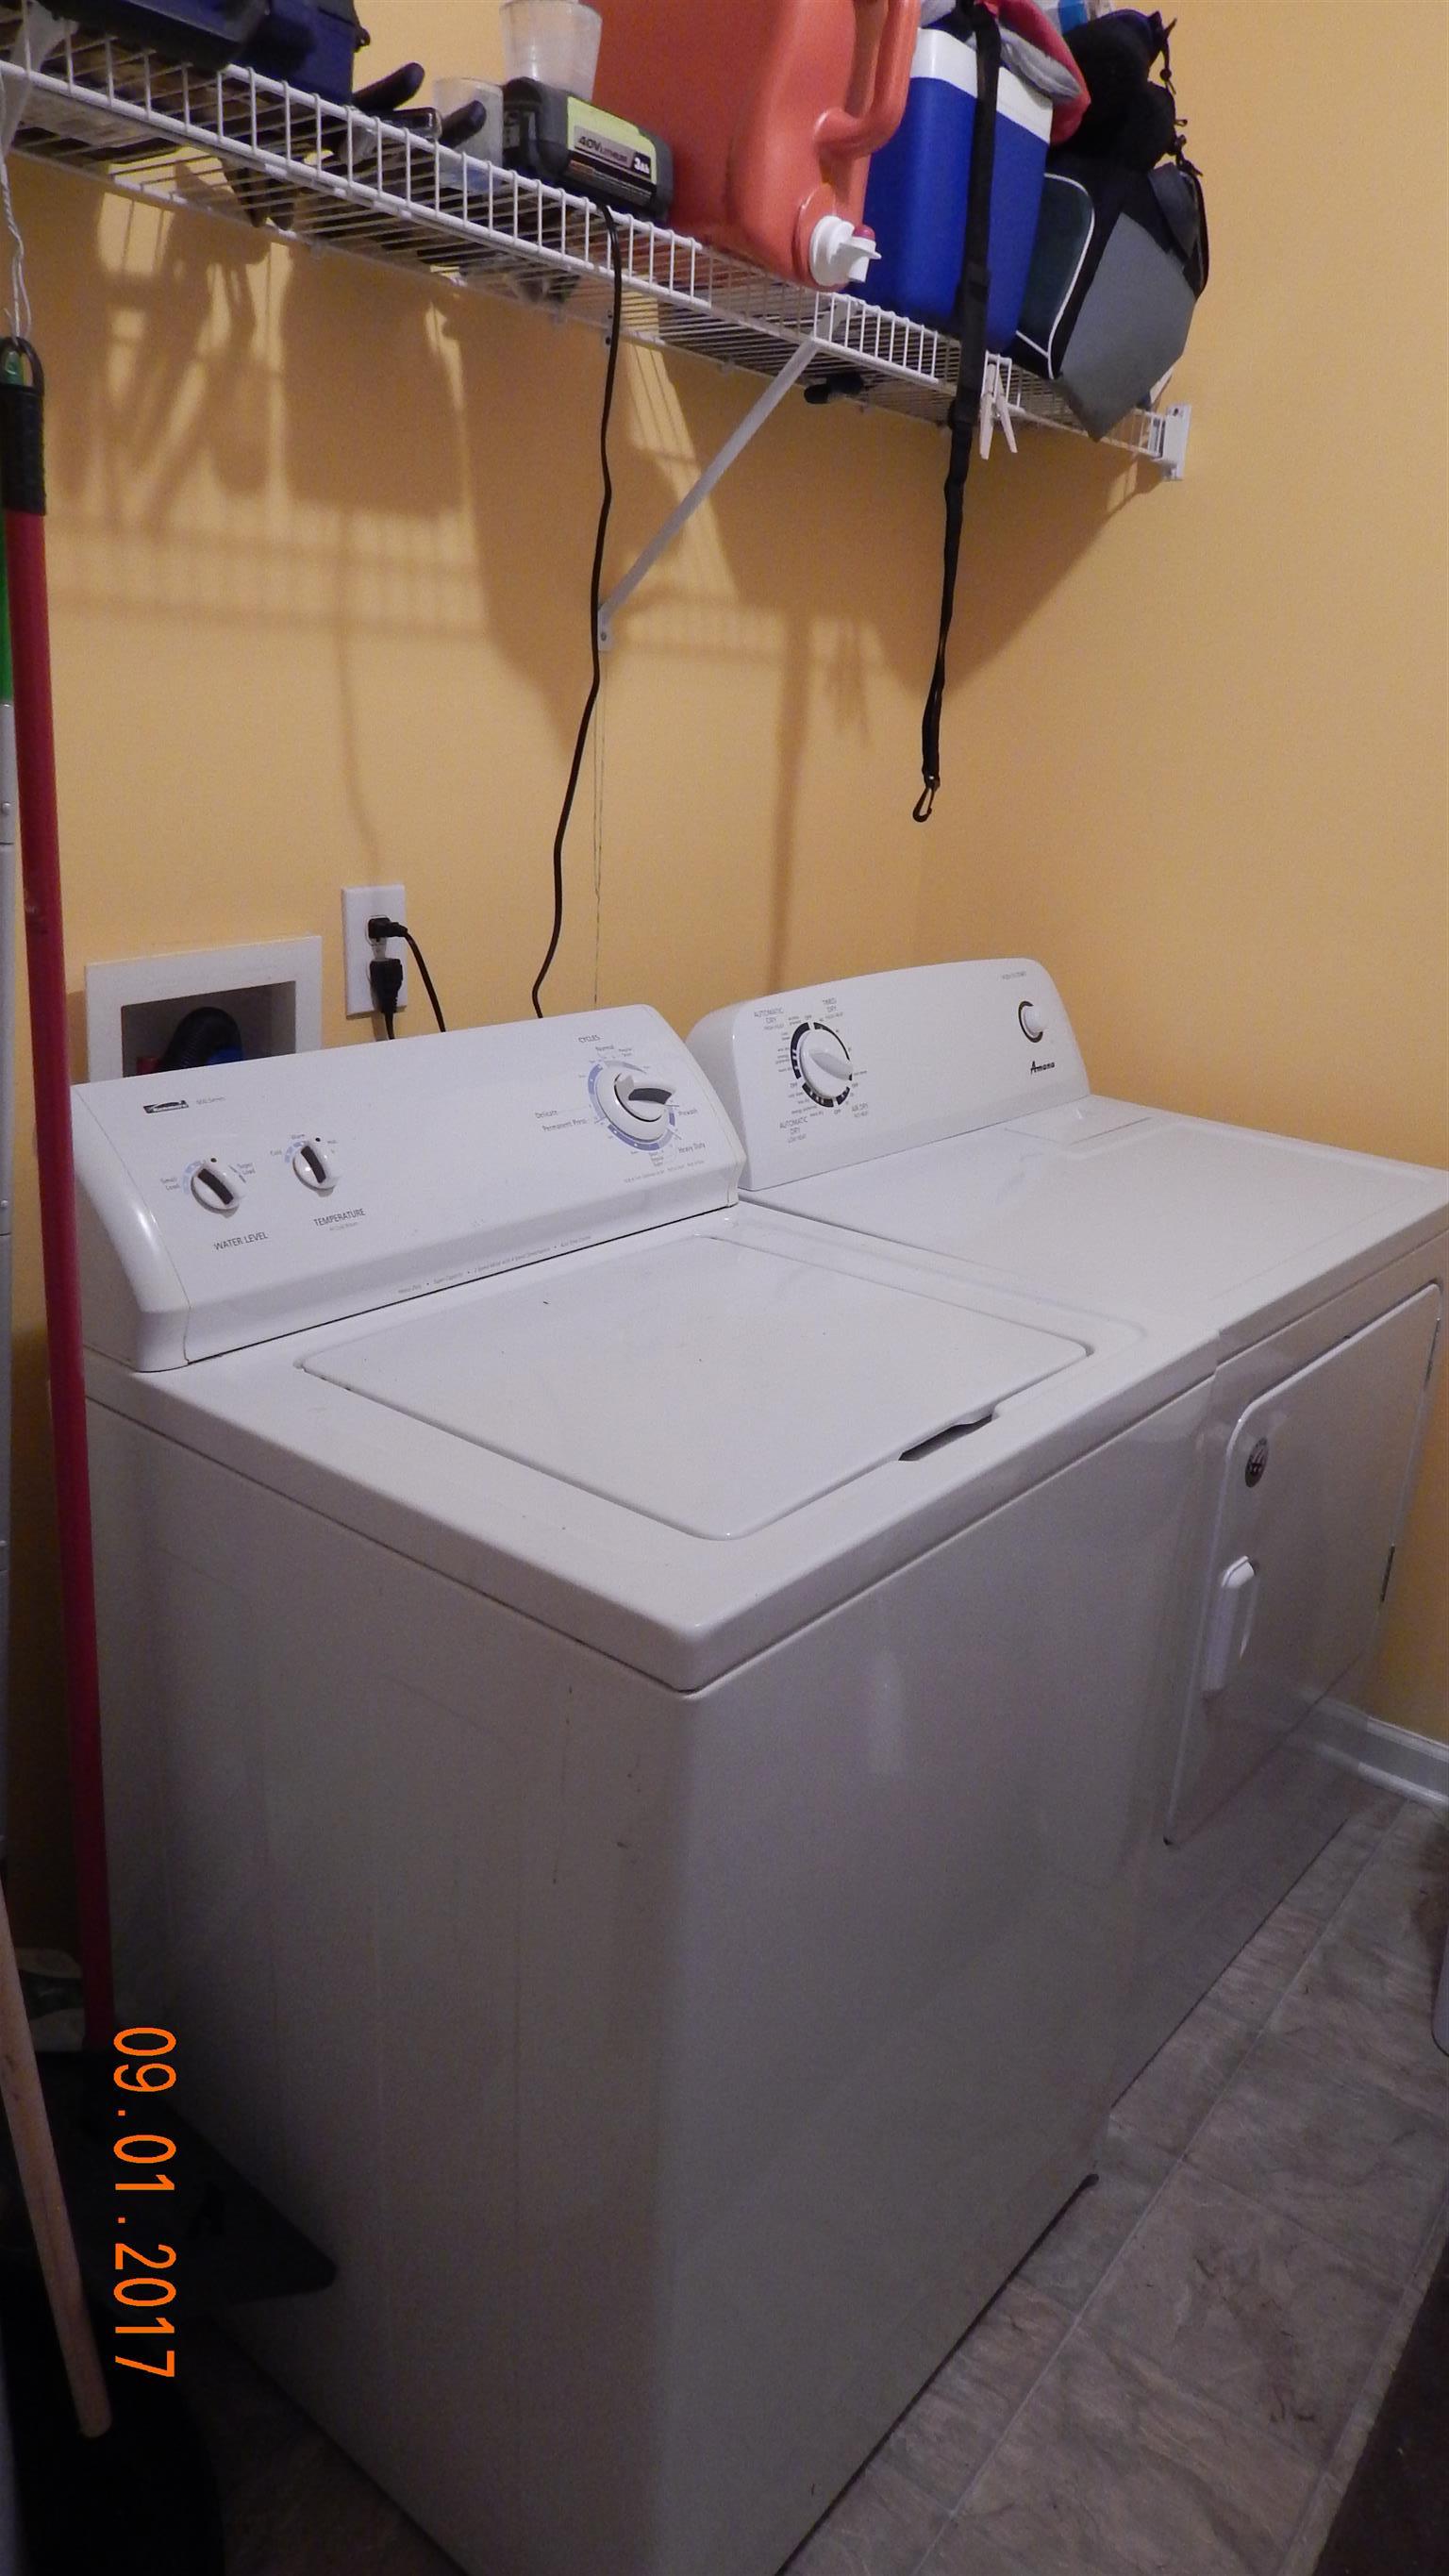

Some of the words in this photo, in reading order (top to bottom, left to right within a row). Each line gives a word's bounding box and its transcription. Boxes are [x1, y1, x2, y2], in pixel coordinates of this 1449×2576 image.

[578, 1034, 601, 1043] CYCLES
[1030, 1061, 1055, 1074] Amana
[313, 1208, 366, 1227] TEMPERATURE
[213, 1237, 243, 1250] WATER
[244, 1230, 269, 1245] LEVEL
